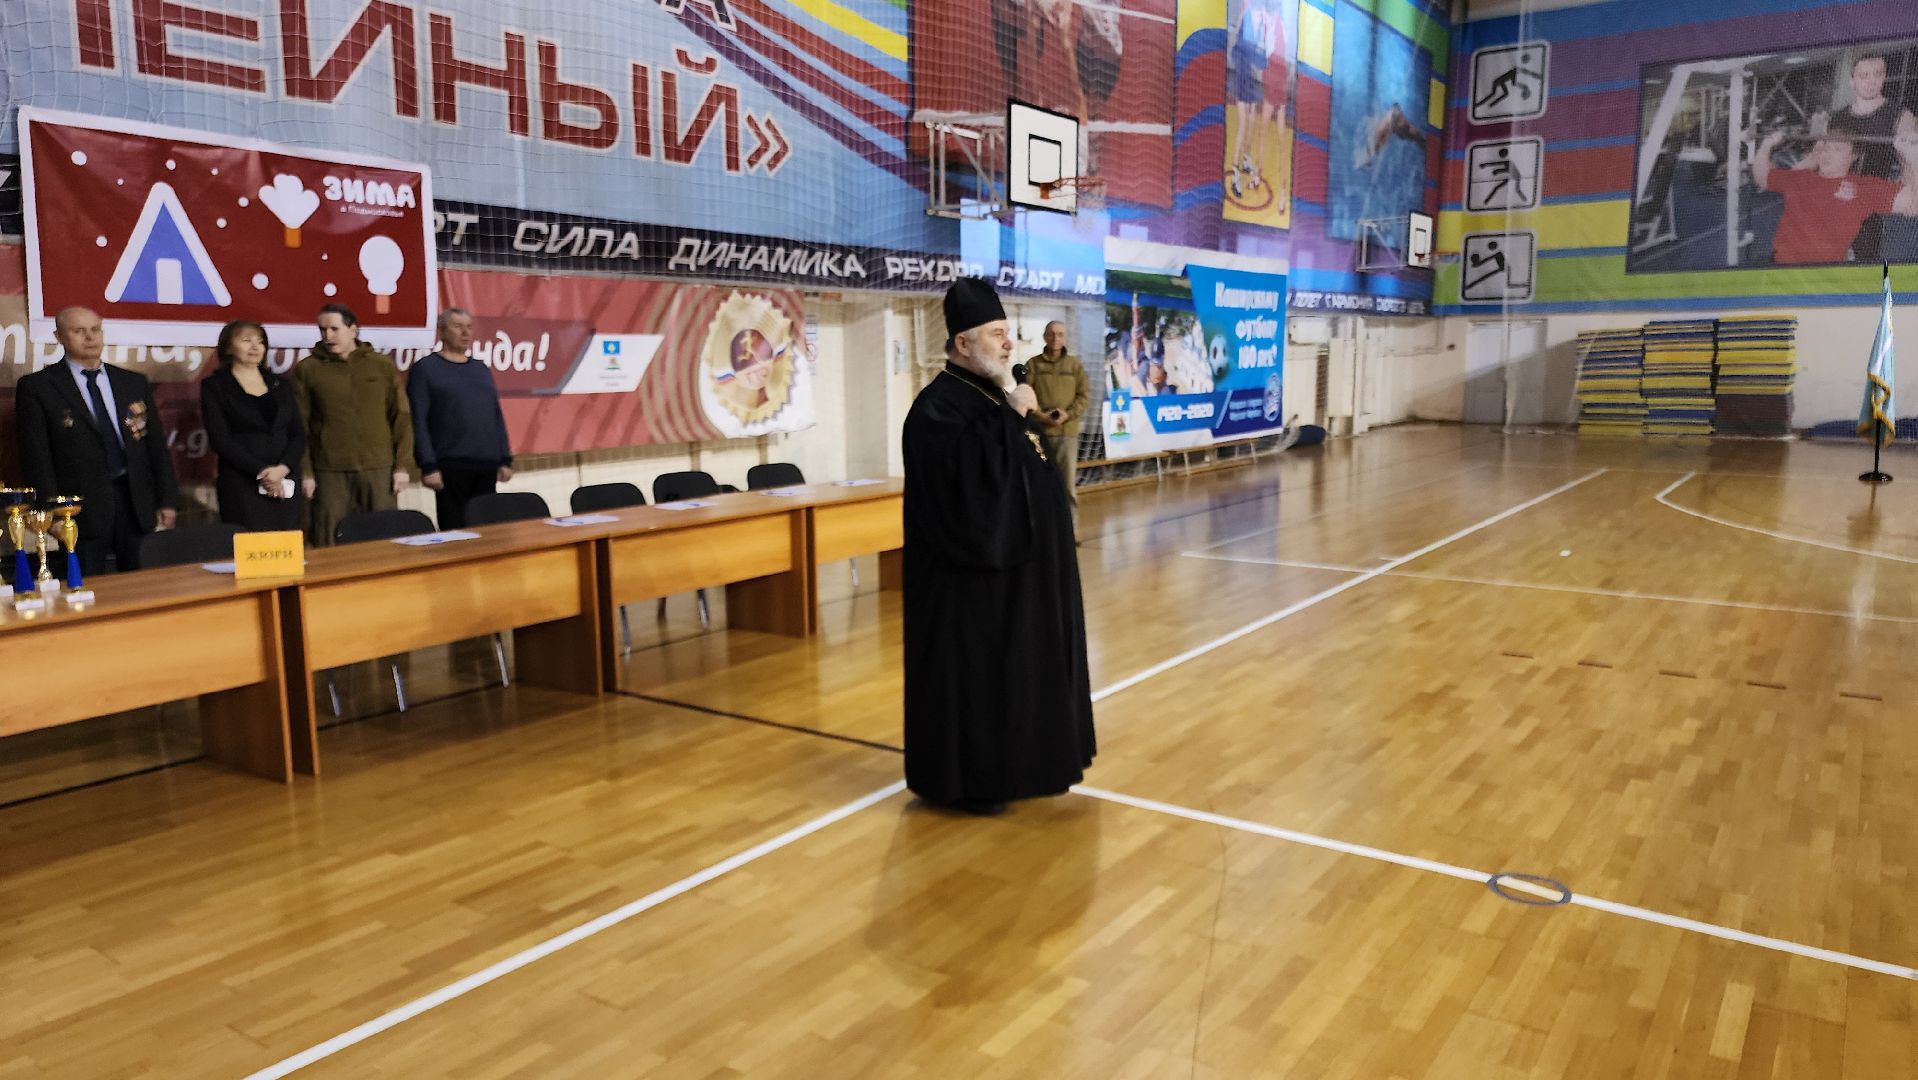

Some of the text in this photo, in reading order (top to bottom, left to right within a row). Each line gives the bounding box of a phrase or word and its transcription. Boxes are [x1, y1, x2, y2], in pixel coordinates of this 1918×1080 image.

[76, 0, 790, 173] ЕЙНЫЙ»
[322, 175, 416, 208] ЗИМА
[513, 220, 640, 261] СИЛА
[668, 237, 867, 279] ДИНАМИКА
[996, 266, 1064, 292] СТАРТ
[1075, 274, 1106, 296] МО
